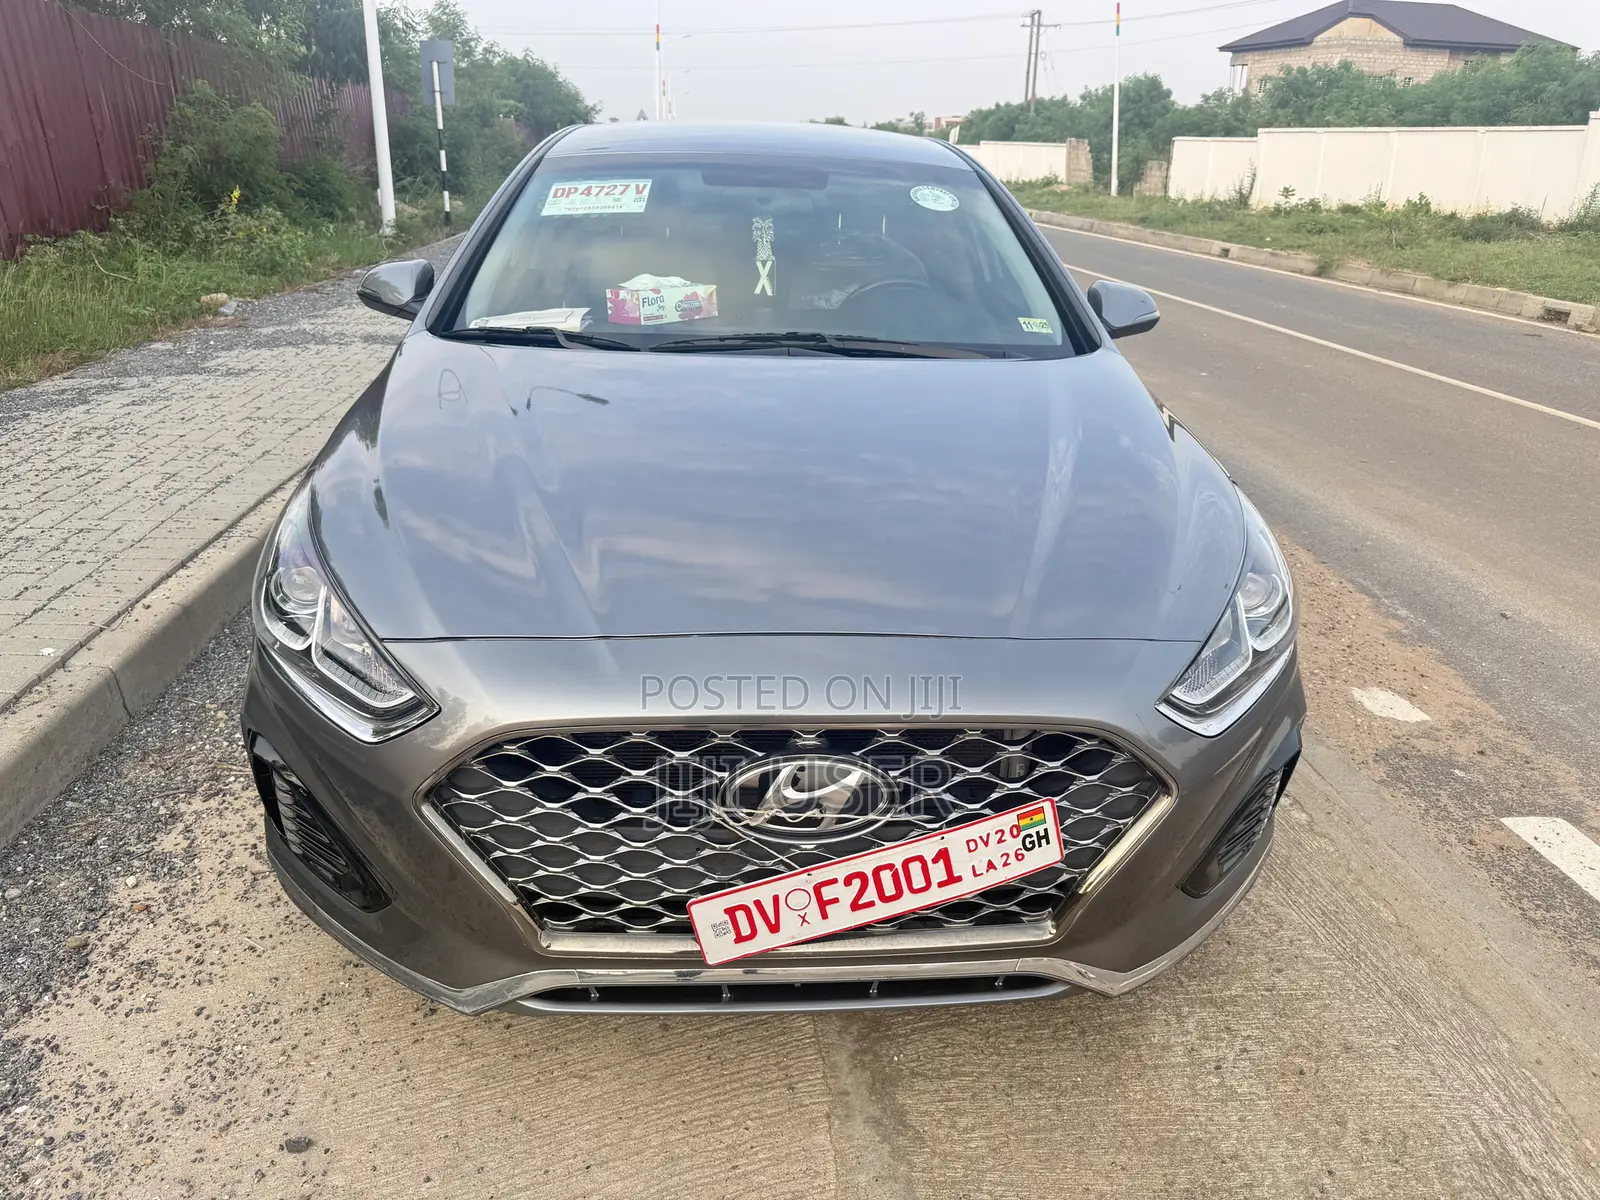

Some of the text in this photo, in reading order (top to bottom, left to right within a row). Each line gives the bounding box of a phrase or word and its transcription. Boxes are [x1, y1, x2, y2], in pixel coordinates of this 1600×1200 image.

[552, 183, 648, 199] DP 4727 V
[642, 295, 665, 308] Flora
[1021, 827, 1051, 852] GH
[723, 847, 963, 944] DV F2001
